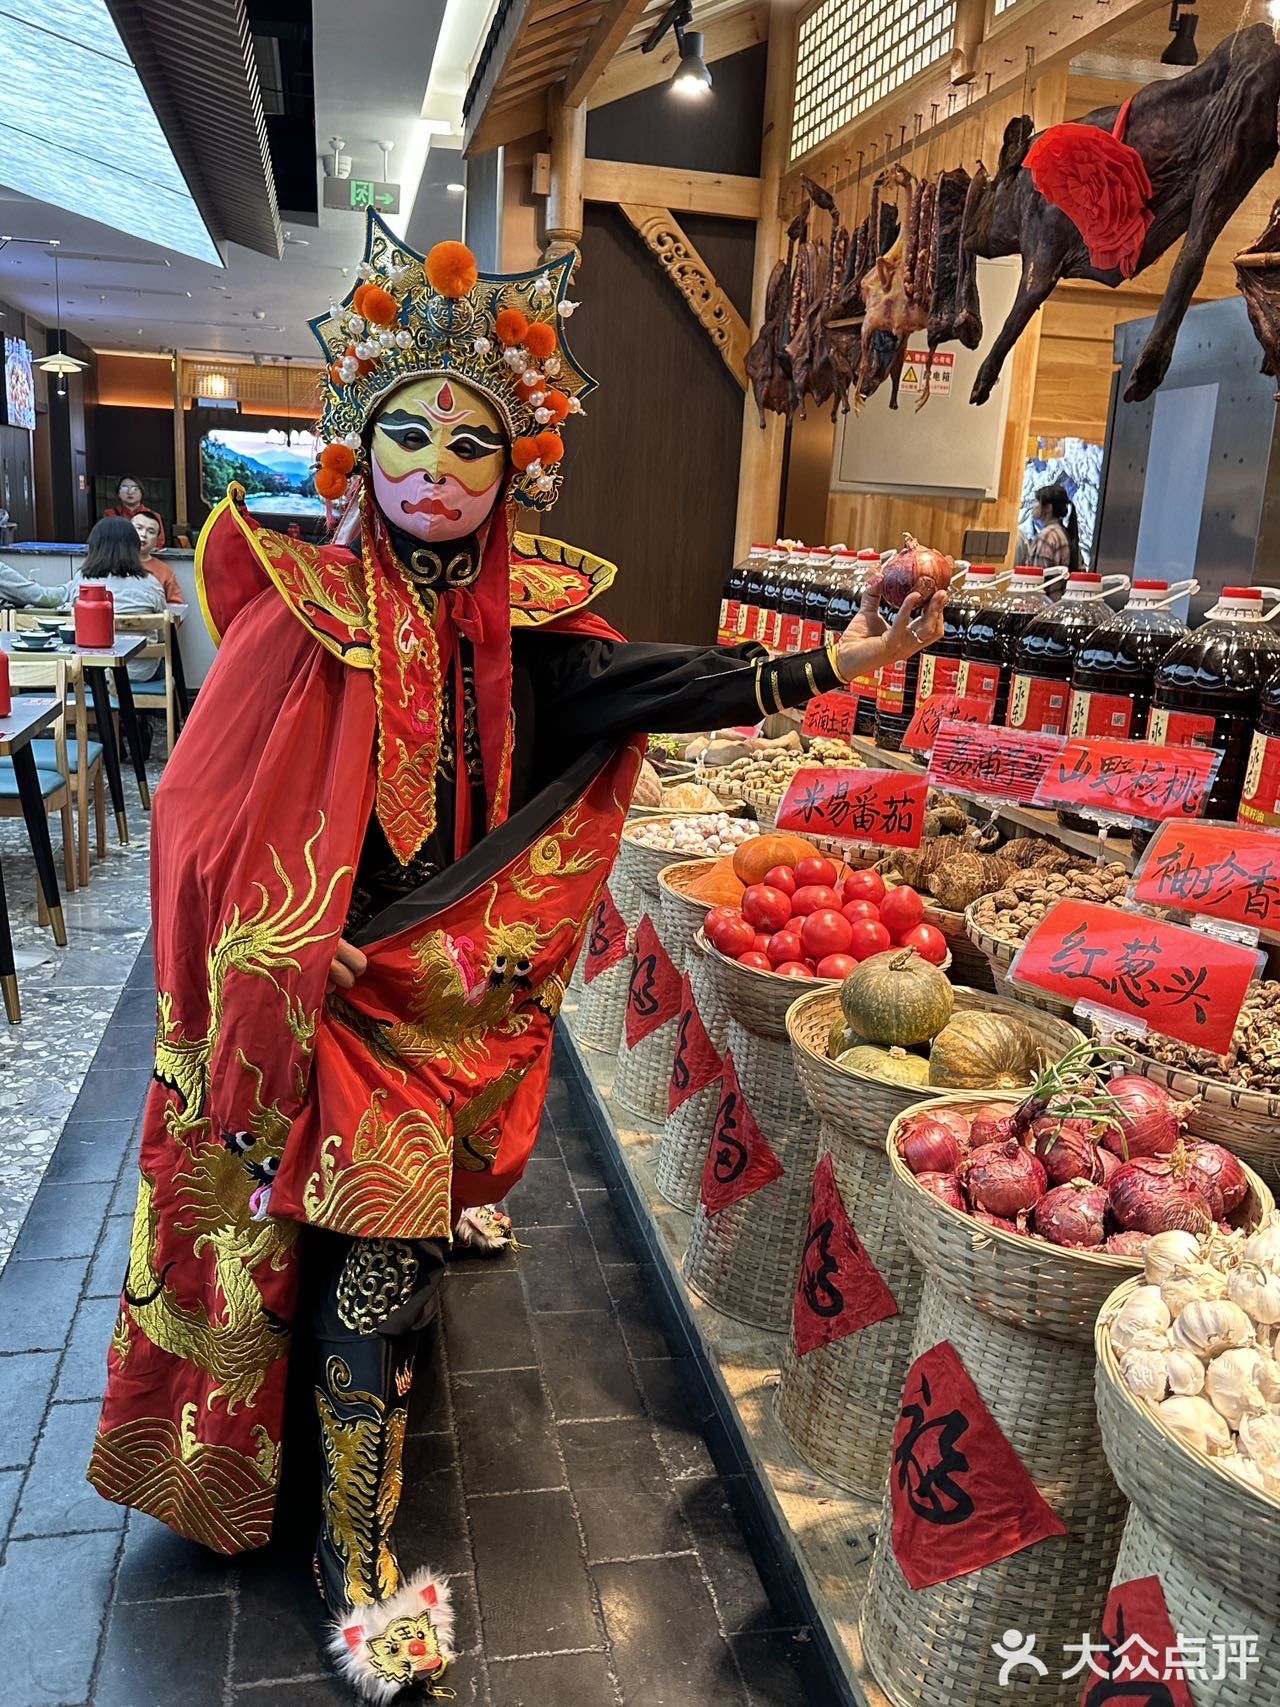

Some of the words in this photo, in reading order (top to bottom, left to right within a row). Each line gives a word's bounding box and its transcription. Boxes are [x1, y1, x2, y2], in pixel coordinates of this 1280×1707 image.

[809, 703, 851, 736] 云南土豆
[792, 779, 916, 834] 米易番茄
[1059, 750, 1200, 814] 山野核桃
[1151, 841, 1280, 919] 袖珍香
[1049, 921, 1211, 1025] 红葱头
